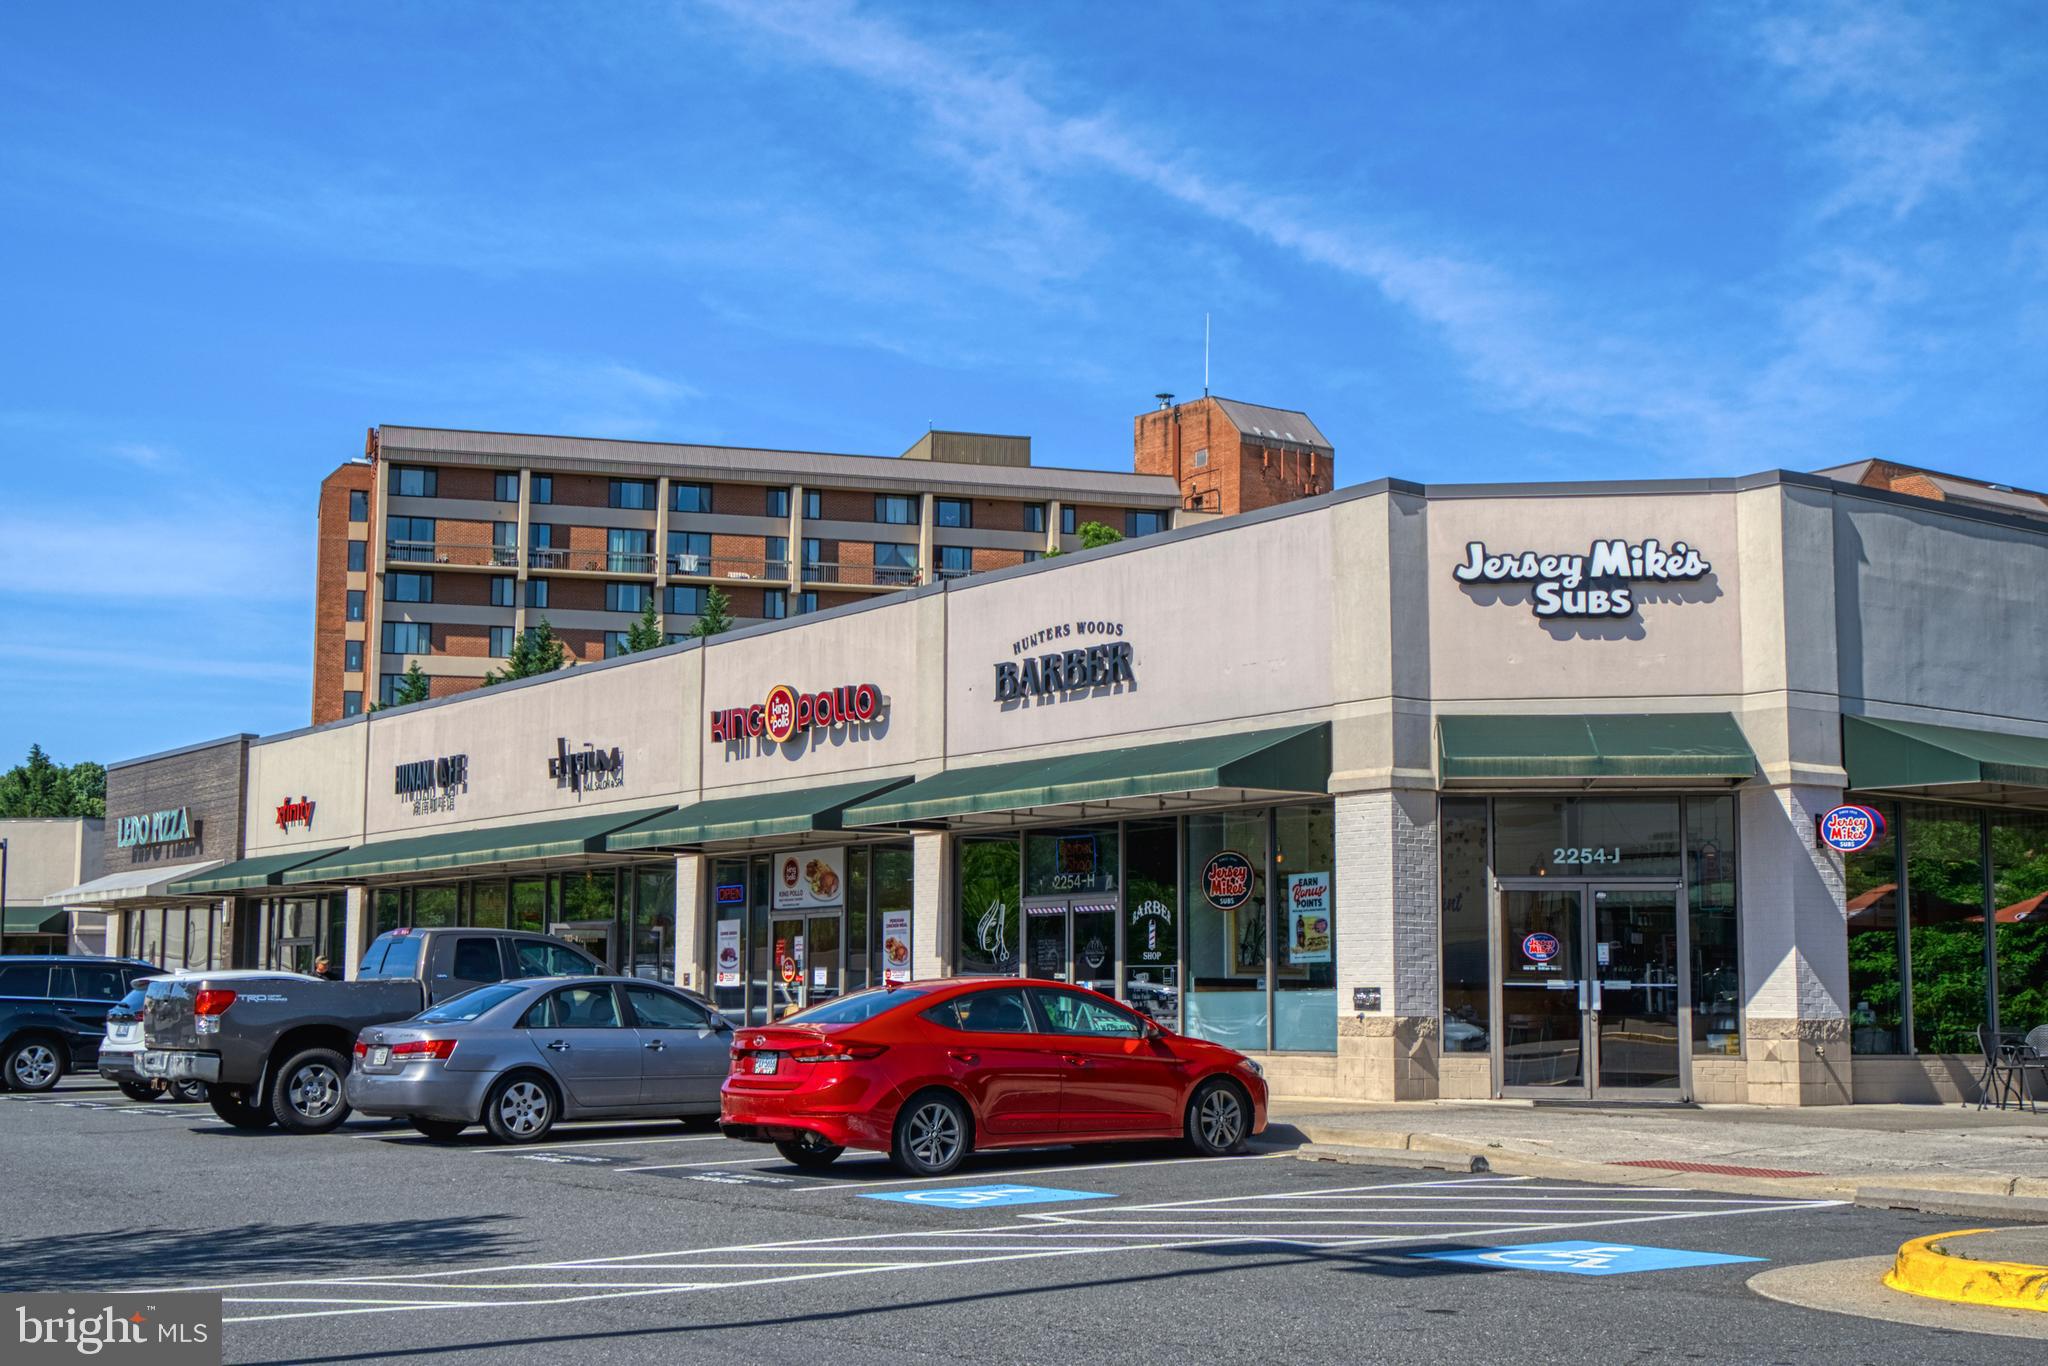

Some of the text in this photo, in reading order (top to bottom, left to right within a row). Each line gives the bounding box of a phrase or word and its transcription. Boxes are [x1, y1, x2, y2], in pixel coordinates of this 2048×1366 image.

[1456, 539, 1710, 589] Jersey Mike's
[1535, 581, 1632, 615] SUBS
[1012, 621, 1124, 655] HUNTERS WOODS
[993, 641, 1136, 702] BARBER
[711, 683, 876, 743] KING POLLO
[772, 700, 790, 717] king
[772, 716, 790, 733] pollo
[395, 760, 434, 795] HUNAN
[275, 796, 313, 831] xfinity
[1828, 813, 1868, 830] Jersey
[118, 806, 191, 848] LEDO PIZZA
[1553, 847, 1621, 865] 2254-J
[1053, 874, 1095, 890] 2254-H
[1208, 862, 1248, 883] Jersey
[1298, 877, 1319, 888] EARN
[1292, 884, 1328, 903] Bonus
[1296, 898, 1323, 909] POINTS
[1142, 951, 1162, 961] SHOP
[238, 993, 267, 1003] TRD
